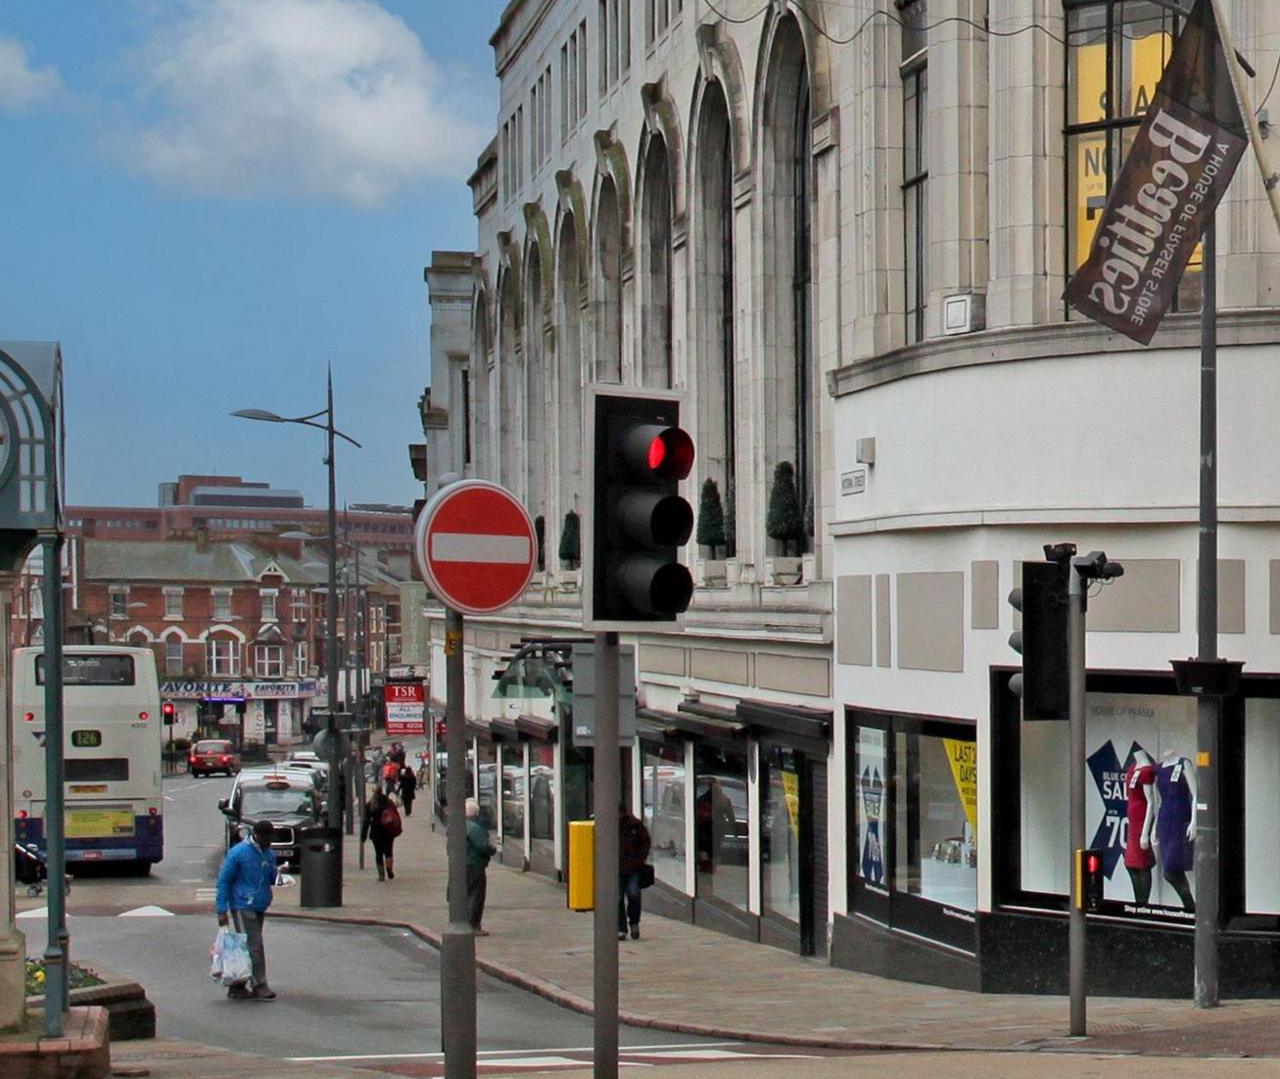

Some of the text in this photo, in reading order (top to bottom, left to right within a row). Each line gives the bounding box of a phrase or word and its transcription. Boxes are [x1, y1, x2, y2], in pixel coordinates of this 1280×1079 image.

[392, 685, 416, 697] TSR
[77, 732, 97, 743] 126
[954, 744, 972, 762] LAST
[1102, 771, 1119, 781] BLUE
[1103, 780, 1129, 801] SAL
